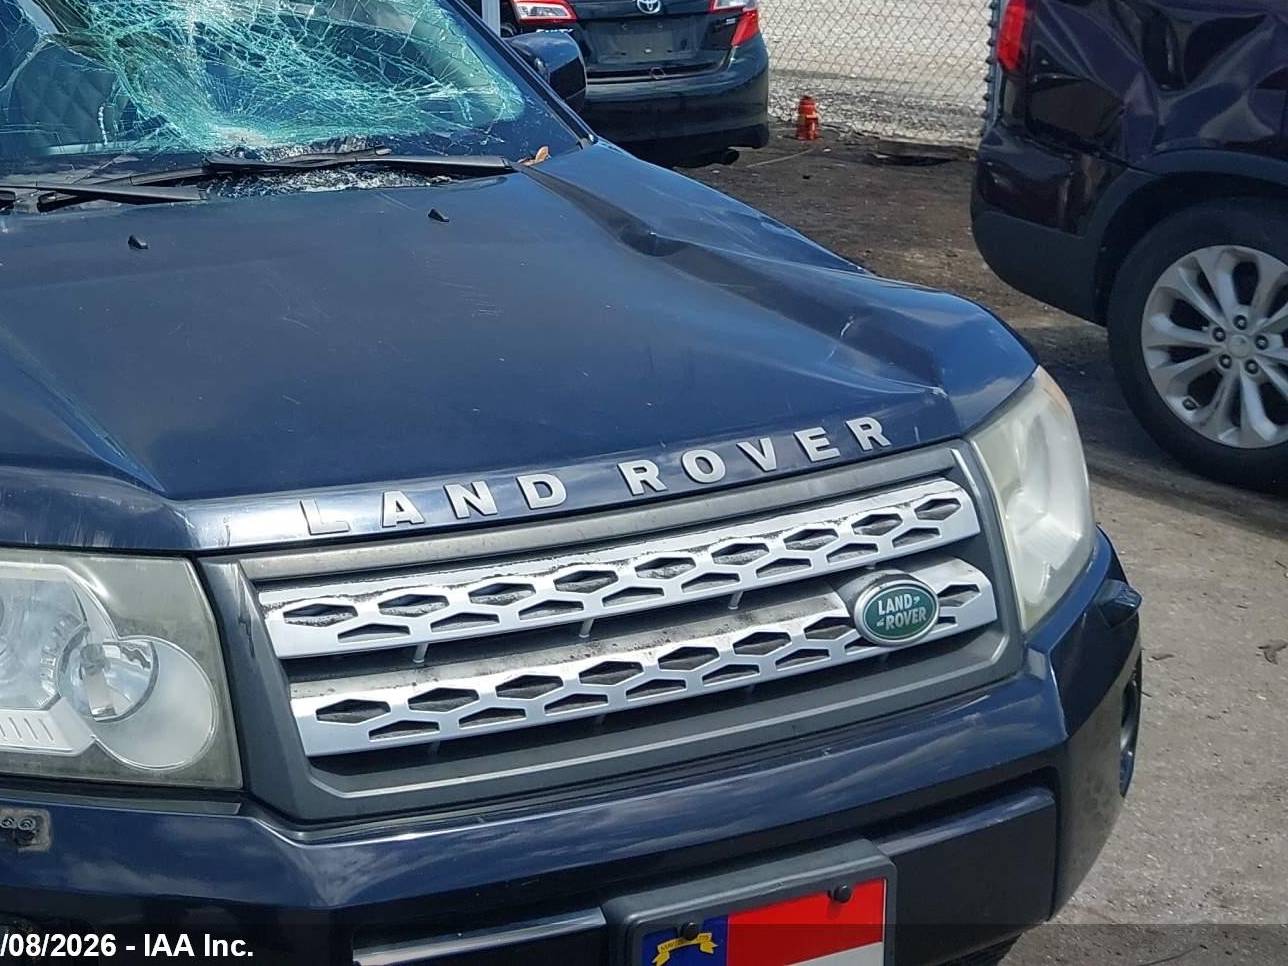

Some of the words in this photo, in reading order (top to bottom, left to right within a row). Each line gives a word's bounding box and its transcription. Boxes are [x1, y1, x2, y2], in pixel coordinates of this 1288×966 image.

[300, 474, 567, 535] LAND
[617, 416, 892, 496] ROVER
[877, 593, 913, 616] LAND
[885, 606, 927, 631] ROVER
